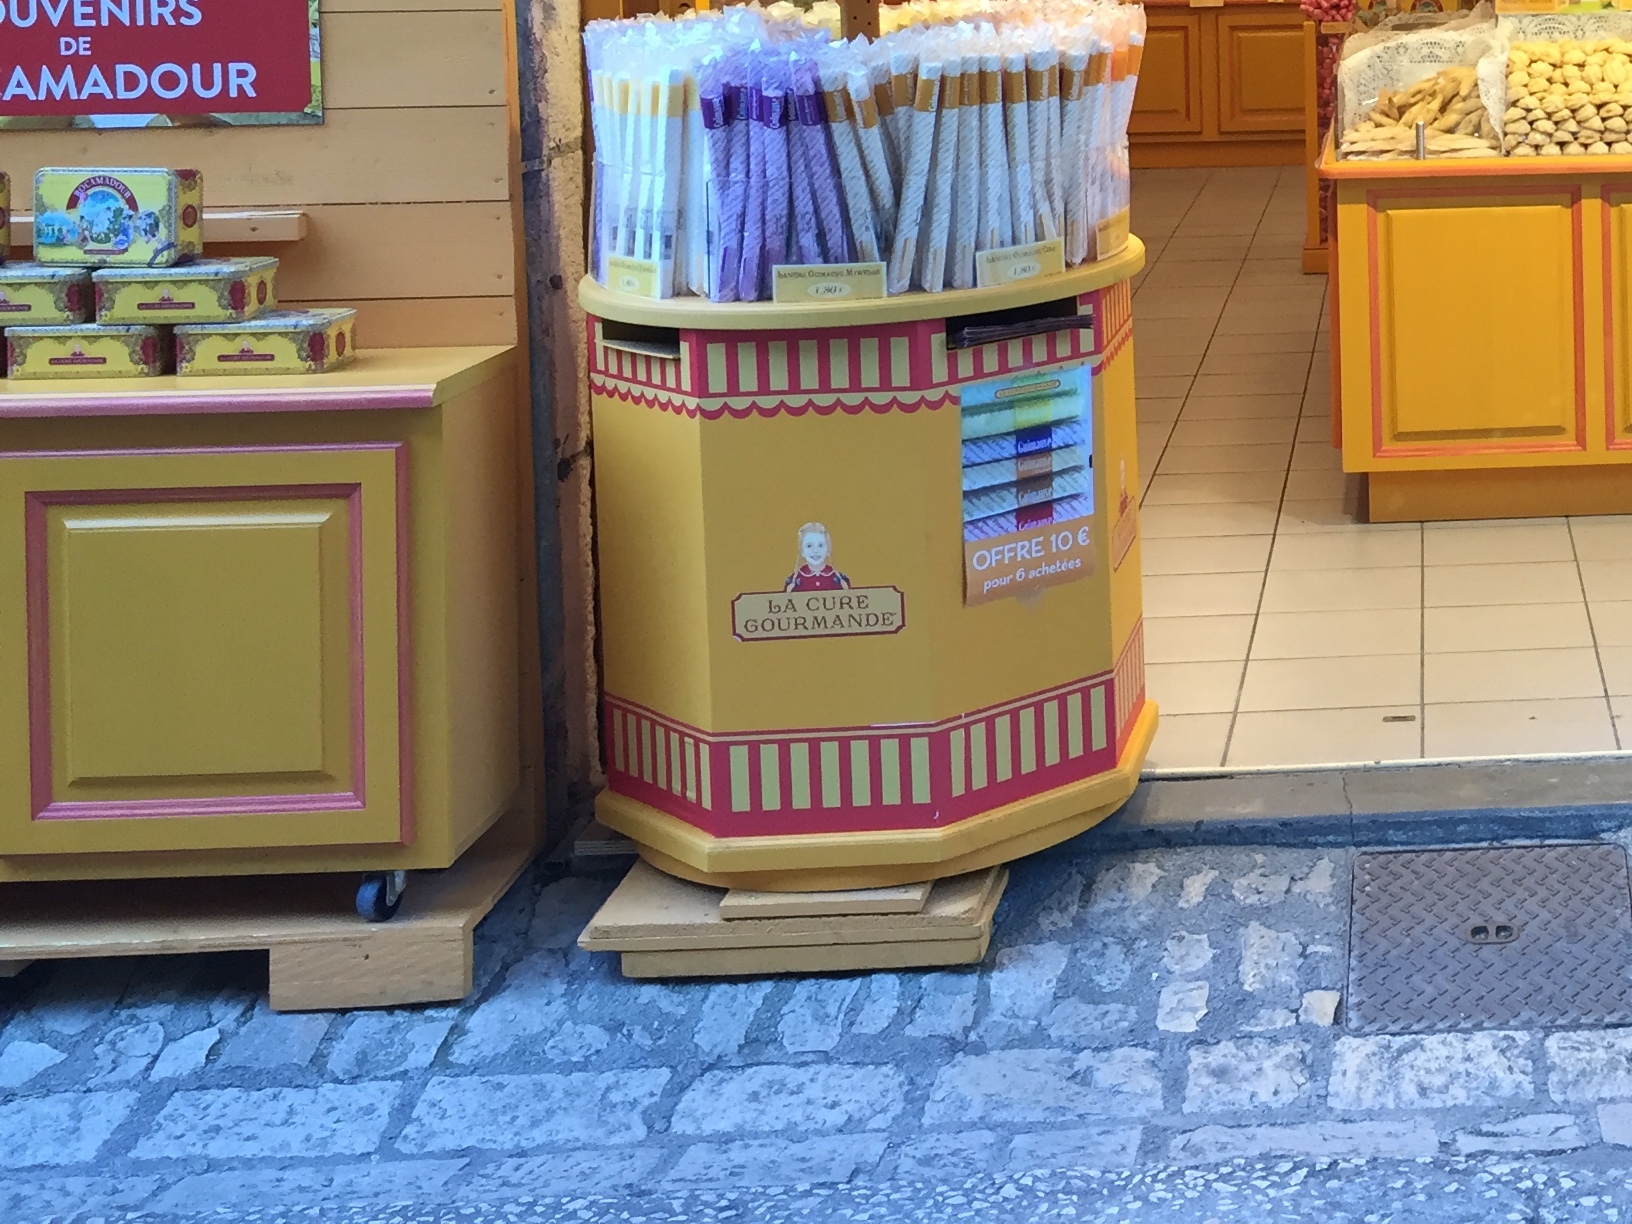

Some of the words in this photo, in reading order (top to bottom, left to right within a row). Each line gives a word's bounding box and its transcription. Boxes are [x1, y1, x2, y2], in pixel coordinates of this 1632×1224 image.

[59, 36, 92, 56] DE
[0, 62, 257, 101] AMADOUR
[74, 176, 132, 200] ROCAMADOUR
[972, 536, 1045, 571] OFFRE
[1049, 530, 1073, 554] 10
[1077, 526, 1090, 546] €
[982, 574, 1013, 594] pour
[1015, 567, 1026, 582] 6
[1028, 557, 1082, 580] achetées
[767, 598, 798, 614] LA
[805, 594, 870, 612] CURE
[743, 610, 897, 634] GOURMANDE
